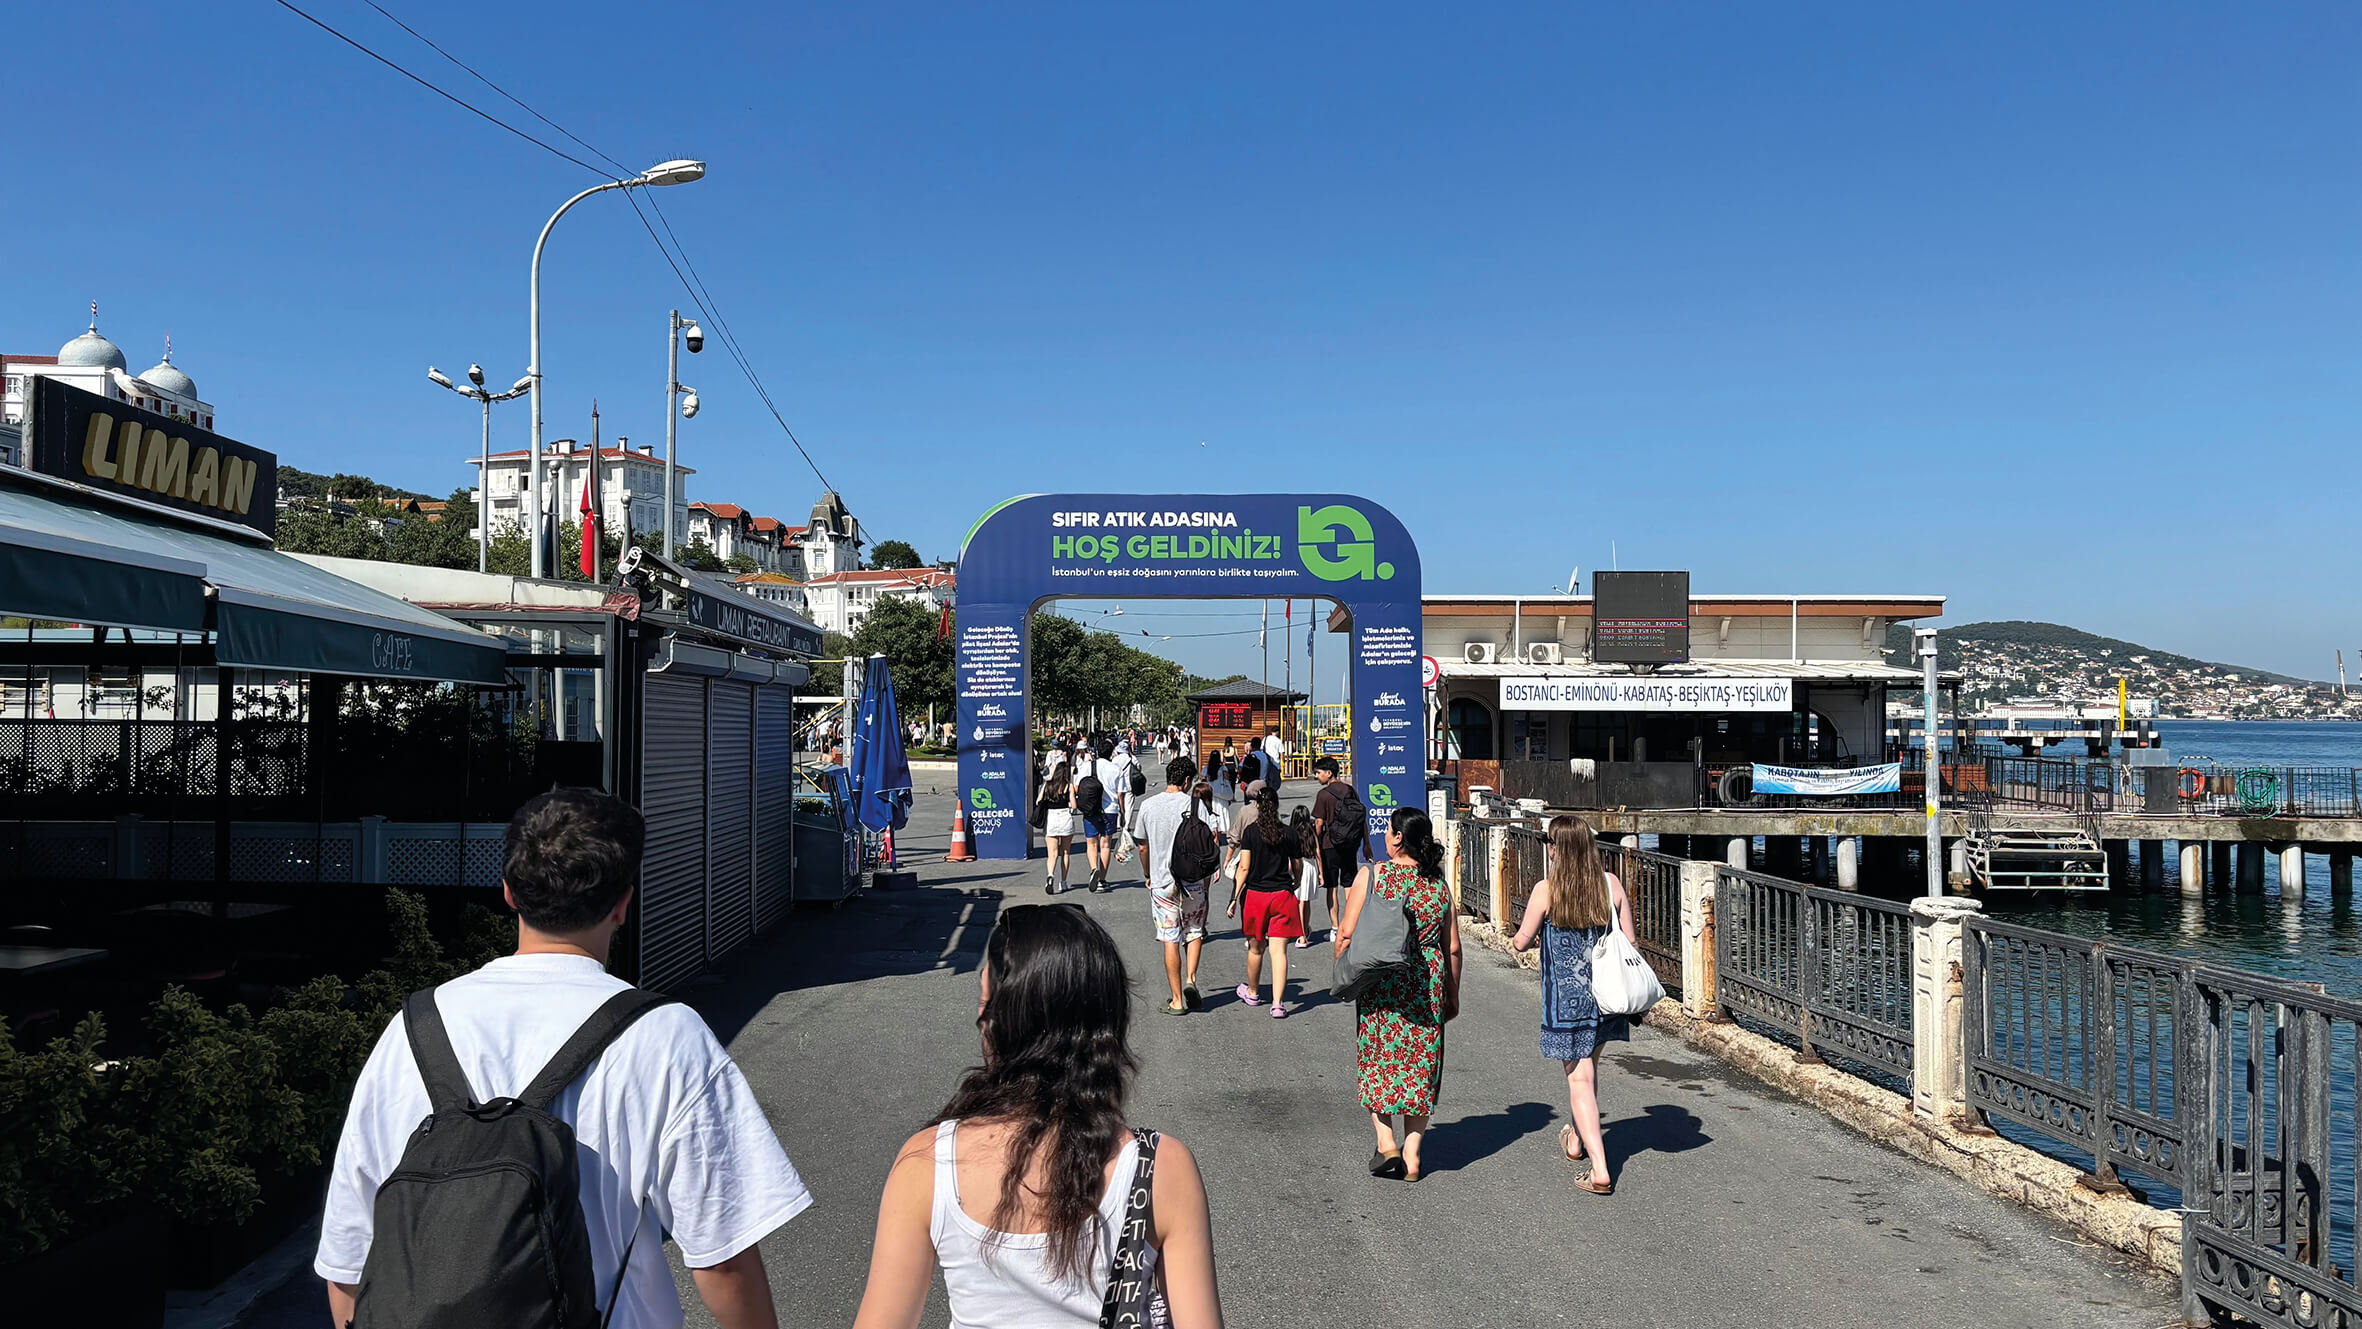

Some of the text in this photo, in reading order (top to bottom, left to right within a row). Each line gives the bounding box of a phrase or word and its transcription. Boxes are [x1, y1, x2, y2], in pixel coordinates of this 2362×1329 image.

[82, 412, 257, 515] LIMAN
[1052, 511, 1237, 527] SIFIR ATIK ADASINA
[1053, 528, 1281, 563] HOŞ GELDİNİZ!
[1052, 565, 1105, 576] İstanbul'un
[1107, 568, 1130, 577] eşsiz
[1132, 567, 1172, 577] doğasını
[1218, 568, 1251, 577] birlikte
[1253, 568, 1300, 578] taşıyalım.
[717, 602, 745, 636] LIMAN
[747, 614, 791, 647] RESTAURANT
[371, 632, 413, 671] CAFE
[1768, 767, 1820, 778] KABOTAJIN
[971, 808, 1014, 818] GELECEĞE
[1369, 808, 1396, 816] GELE
